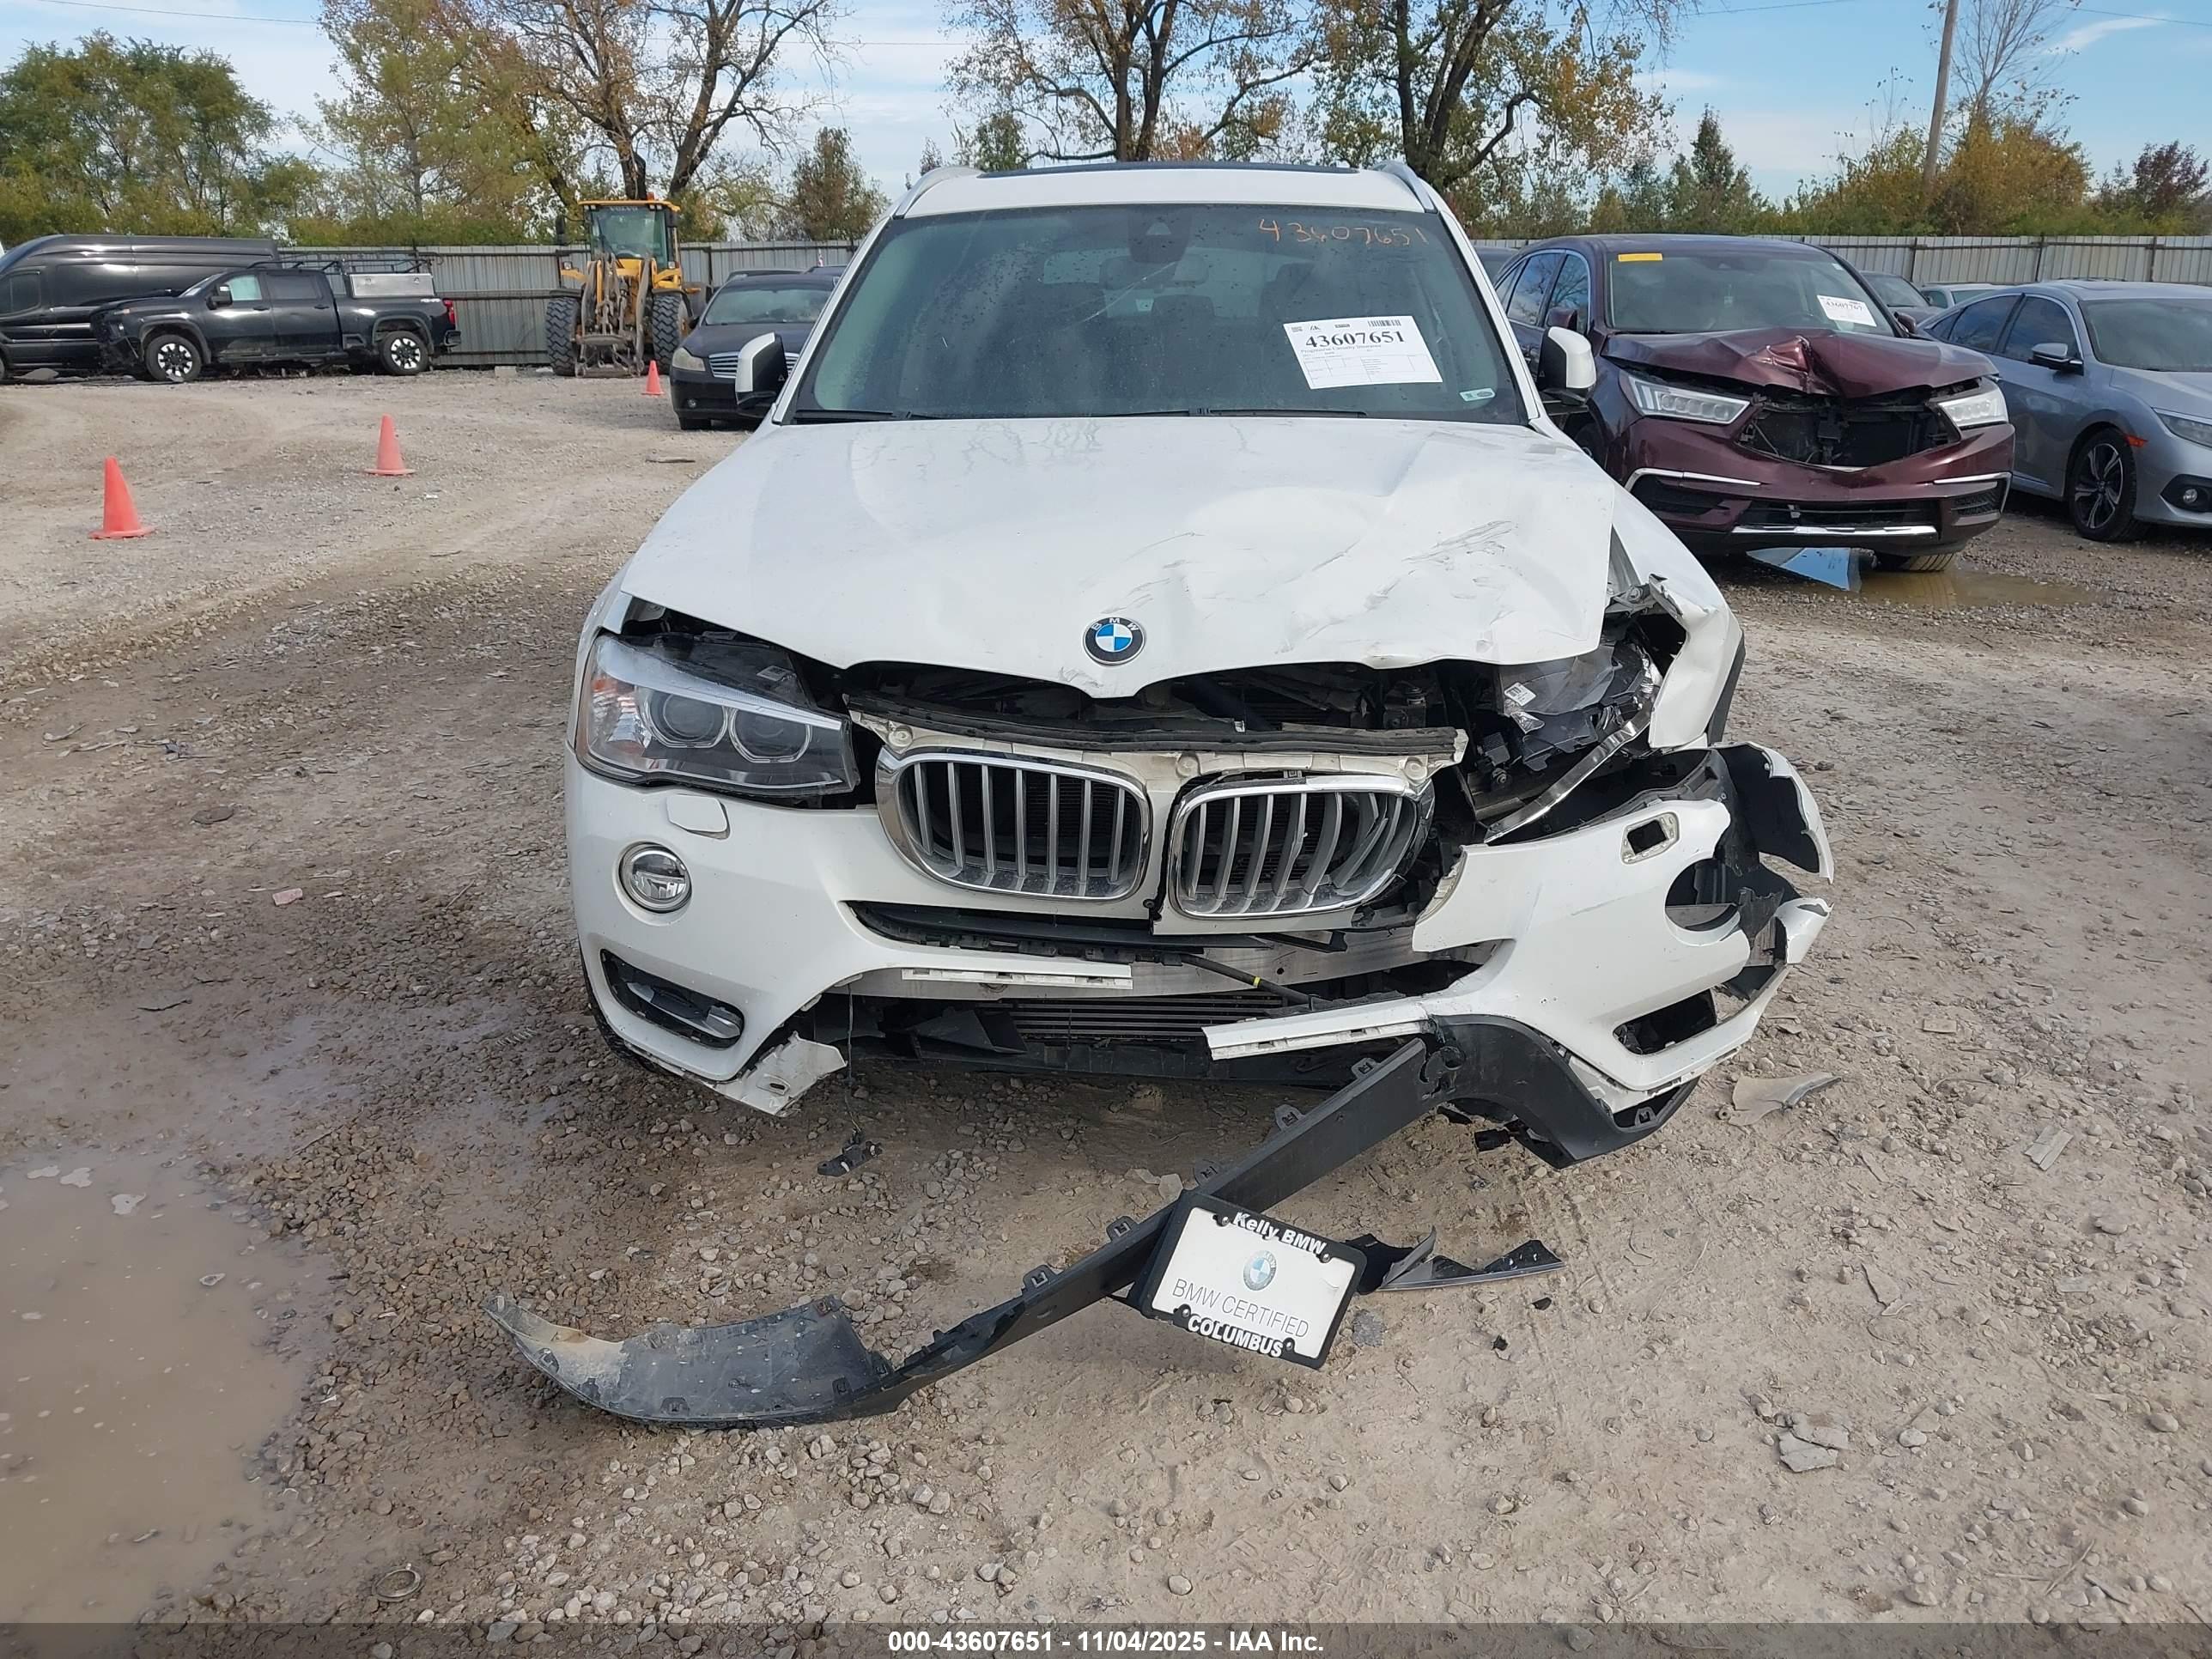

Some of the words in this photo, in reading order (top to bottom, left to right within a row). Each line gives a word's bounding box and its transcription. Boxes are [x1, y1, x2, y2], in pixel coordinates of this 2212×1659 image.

[1259, 218, 1430, 246] 43607651
[1305, 331, 1405, 348] 43607651
[1091, 617, 1139, 631] BMW
[1233, 1212, 1279, 1239] Kelly
[1280, 1229, 1327, 1255] BMW
[1172, 1278, 1221, 1308] BMW
[1222, 1296, 1309, 1337] CERTIFIED
[1188, 1315, 1284, 1358] COLUMBUS
